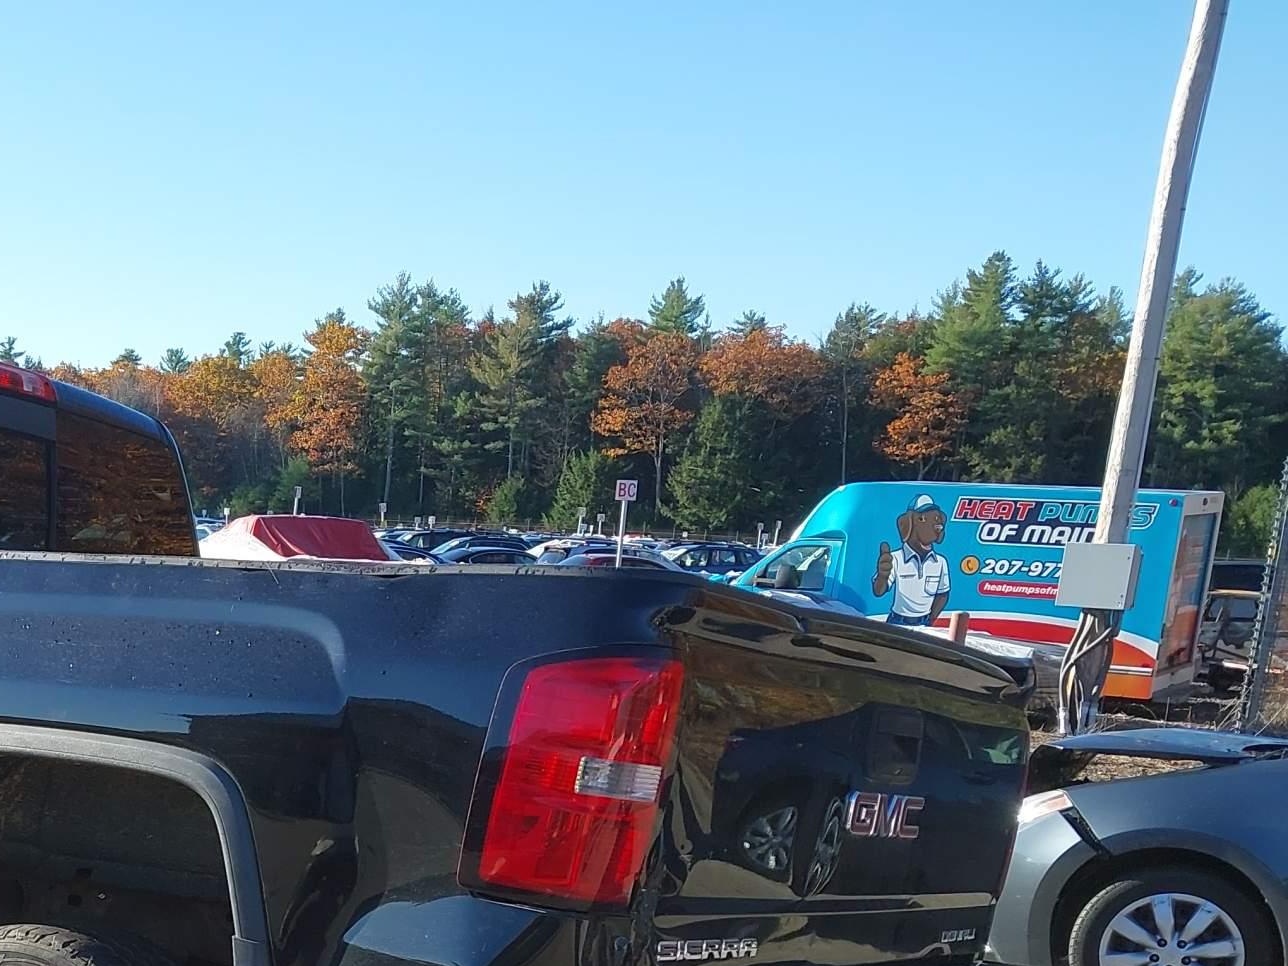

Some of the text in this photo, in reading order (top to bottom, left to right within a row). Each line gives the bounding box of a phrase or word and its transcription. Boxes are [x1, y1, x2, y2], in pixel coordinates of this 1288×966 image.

[618, 482, 637, 498] BC
[955, 499, 1154, 525] HEAT PUMS
[980, 522, 1019, 541] OF
[846, 791, 926, 838] GMC
[657, 938, 759, 962] SIERRA
